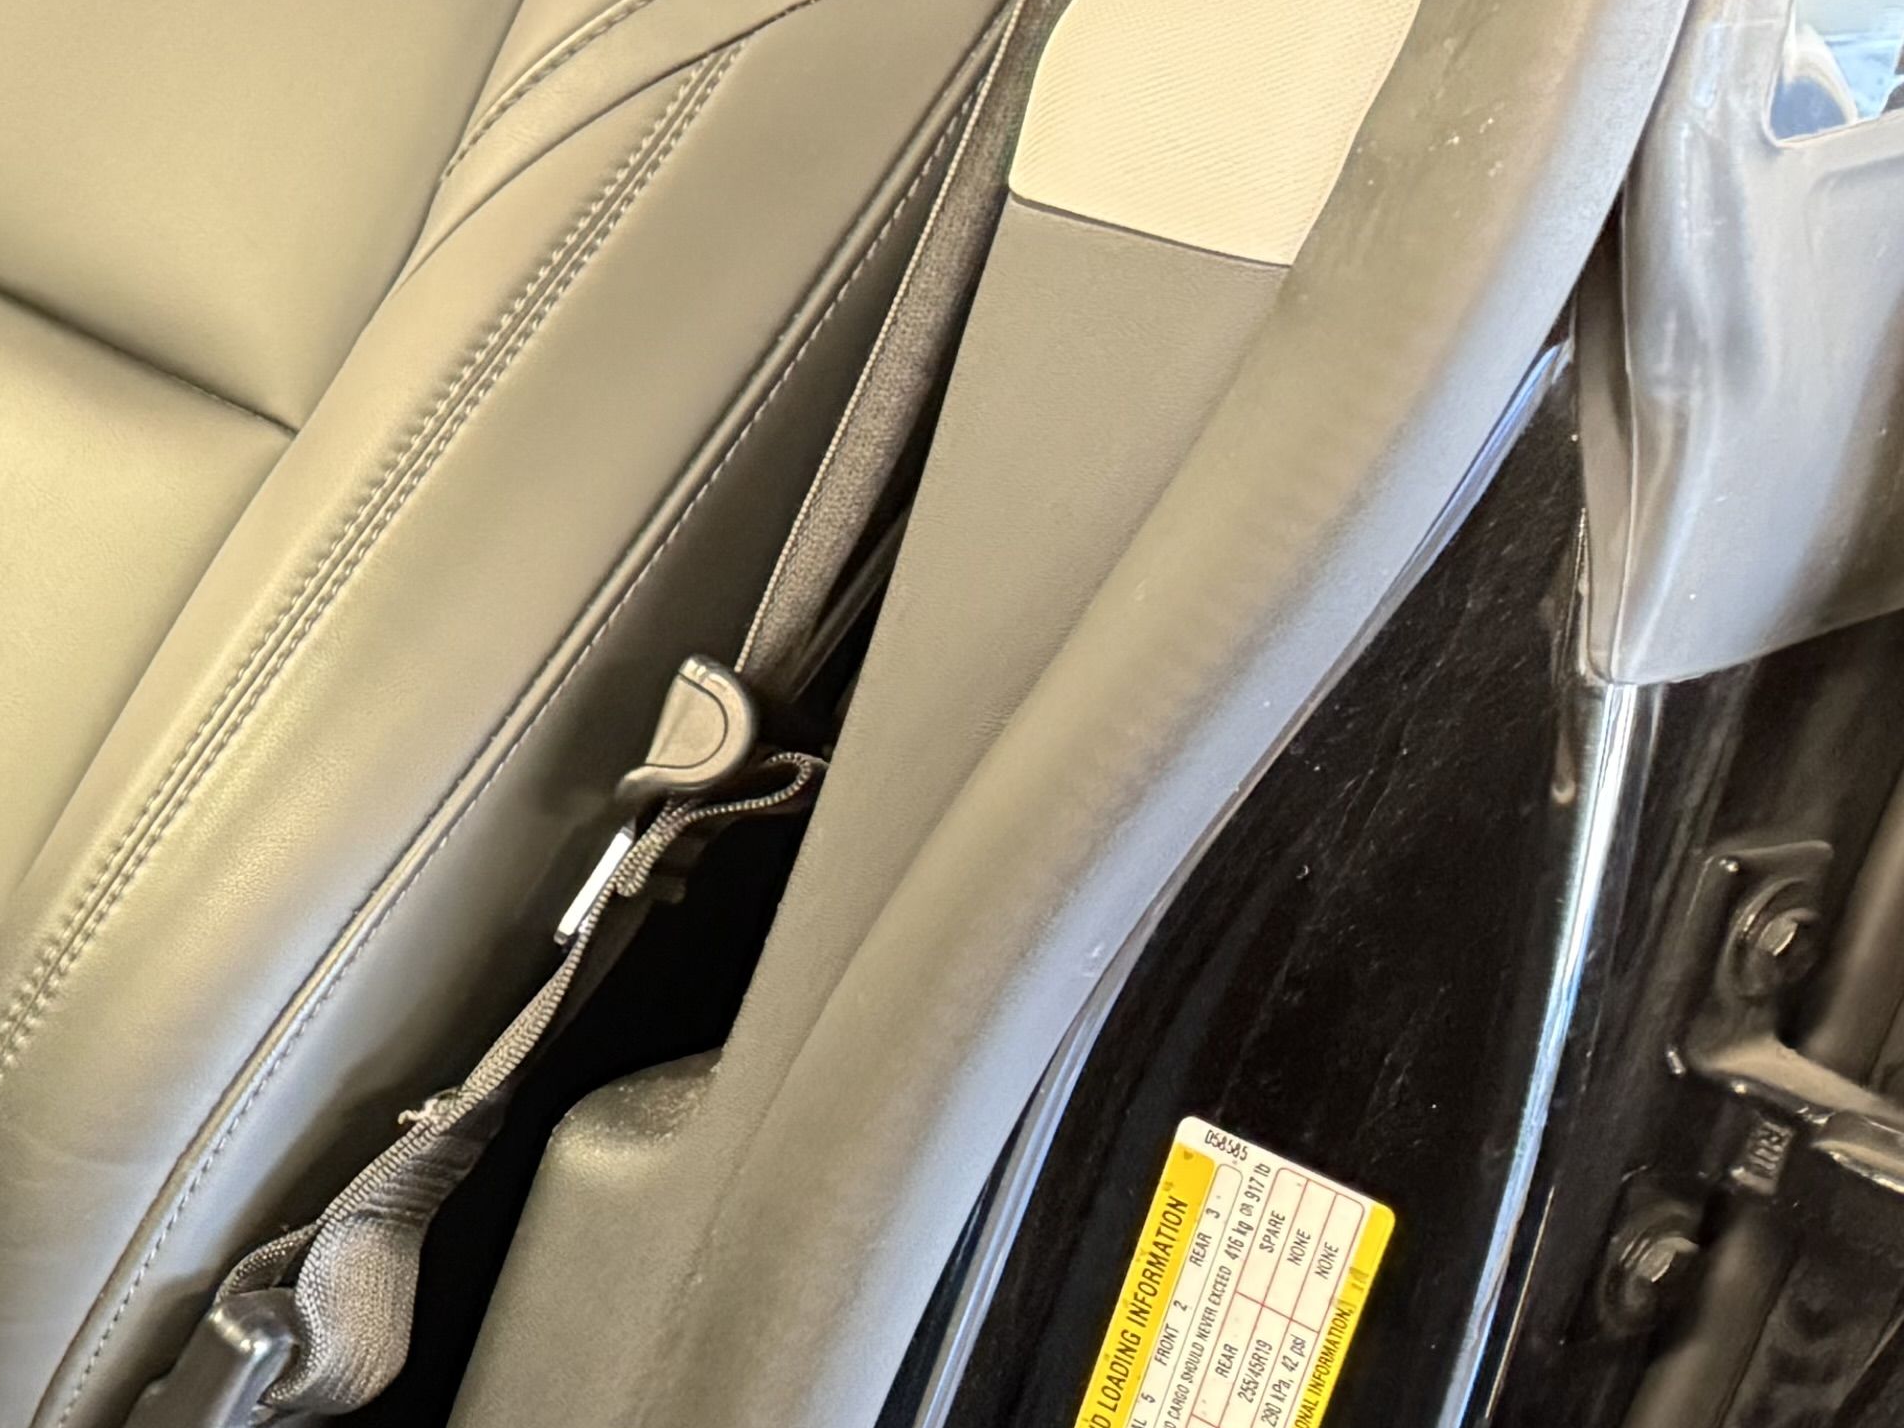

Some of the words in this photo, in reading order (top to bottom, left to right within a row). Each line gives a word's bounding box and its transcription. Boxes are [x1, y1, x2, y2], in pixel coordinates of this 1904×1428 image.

[1242, 1175, 1266, 1203] 917
[1223, 1235, 1245, 1261] 416
[1230, 1219, 1255, 1237] kg
[1258, 1209, 1286, 1254] SPARE
[1285, 1227, 1312, 1267] NONE
[1188, 1231, 1213, 1268] REAR
[1313, 1240, 1340, 1280] NONE
[1096, 1328, 1142, 1413] LOADING
[1125, 1194, 1189, 1329] INFORMATION
[1206, 1264, 1233, 1307] EXCEED
[1194, 1305, 1218, 1342] NEVER
[1153, 1322, 1179, 1367] FRONT
[1179, 1340, 1206, 1385] SHOULD
[1213, 1342, 1239, 1379] REAR
[1236, 1338, 1273, 1404] 255/45R19
[1259, 1401, 1283, 1428] 290
[1280, 1354, 1300, 1373] 42
[1166, 1382, 1191, 1421] CARGO
